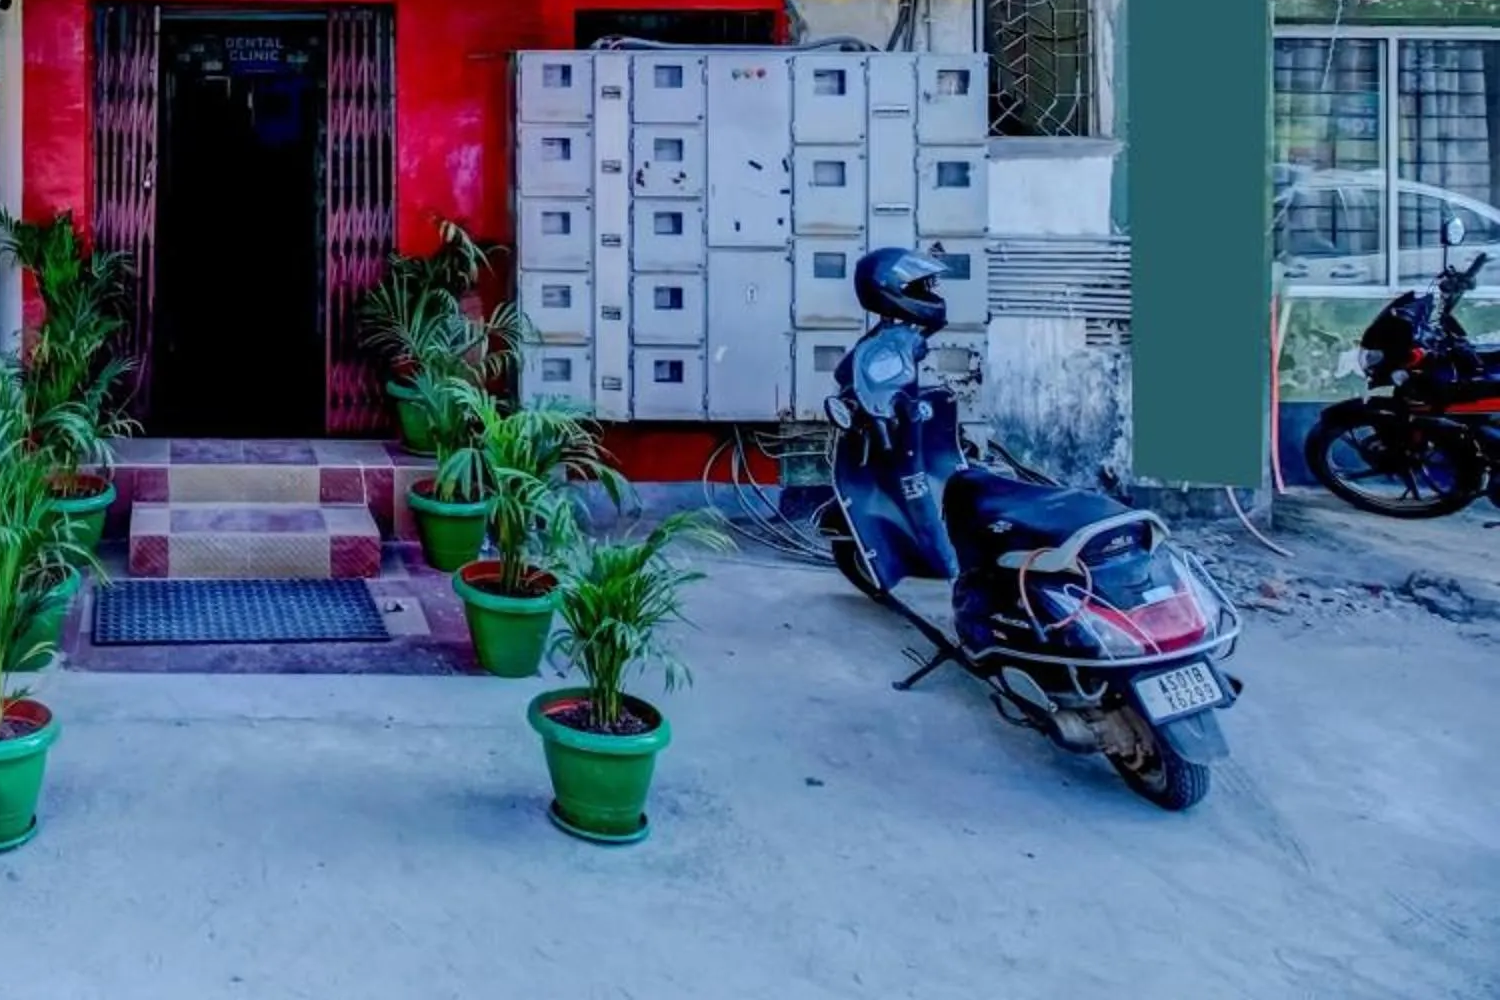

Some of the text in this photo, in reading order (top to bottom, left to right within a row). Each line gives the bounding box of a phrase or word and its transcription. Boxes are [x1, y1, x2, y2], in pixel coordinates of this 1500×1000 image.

[225, 37, 283, 49] DENTAL
[229, 50, 280, 62] CLINIC
[1157, 667, 1204, 694] AS01B
[1164, 683, 1214, 711] X6299
